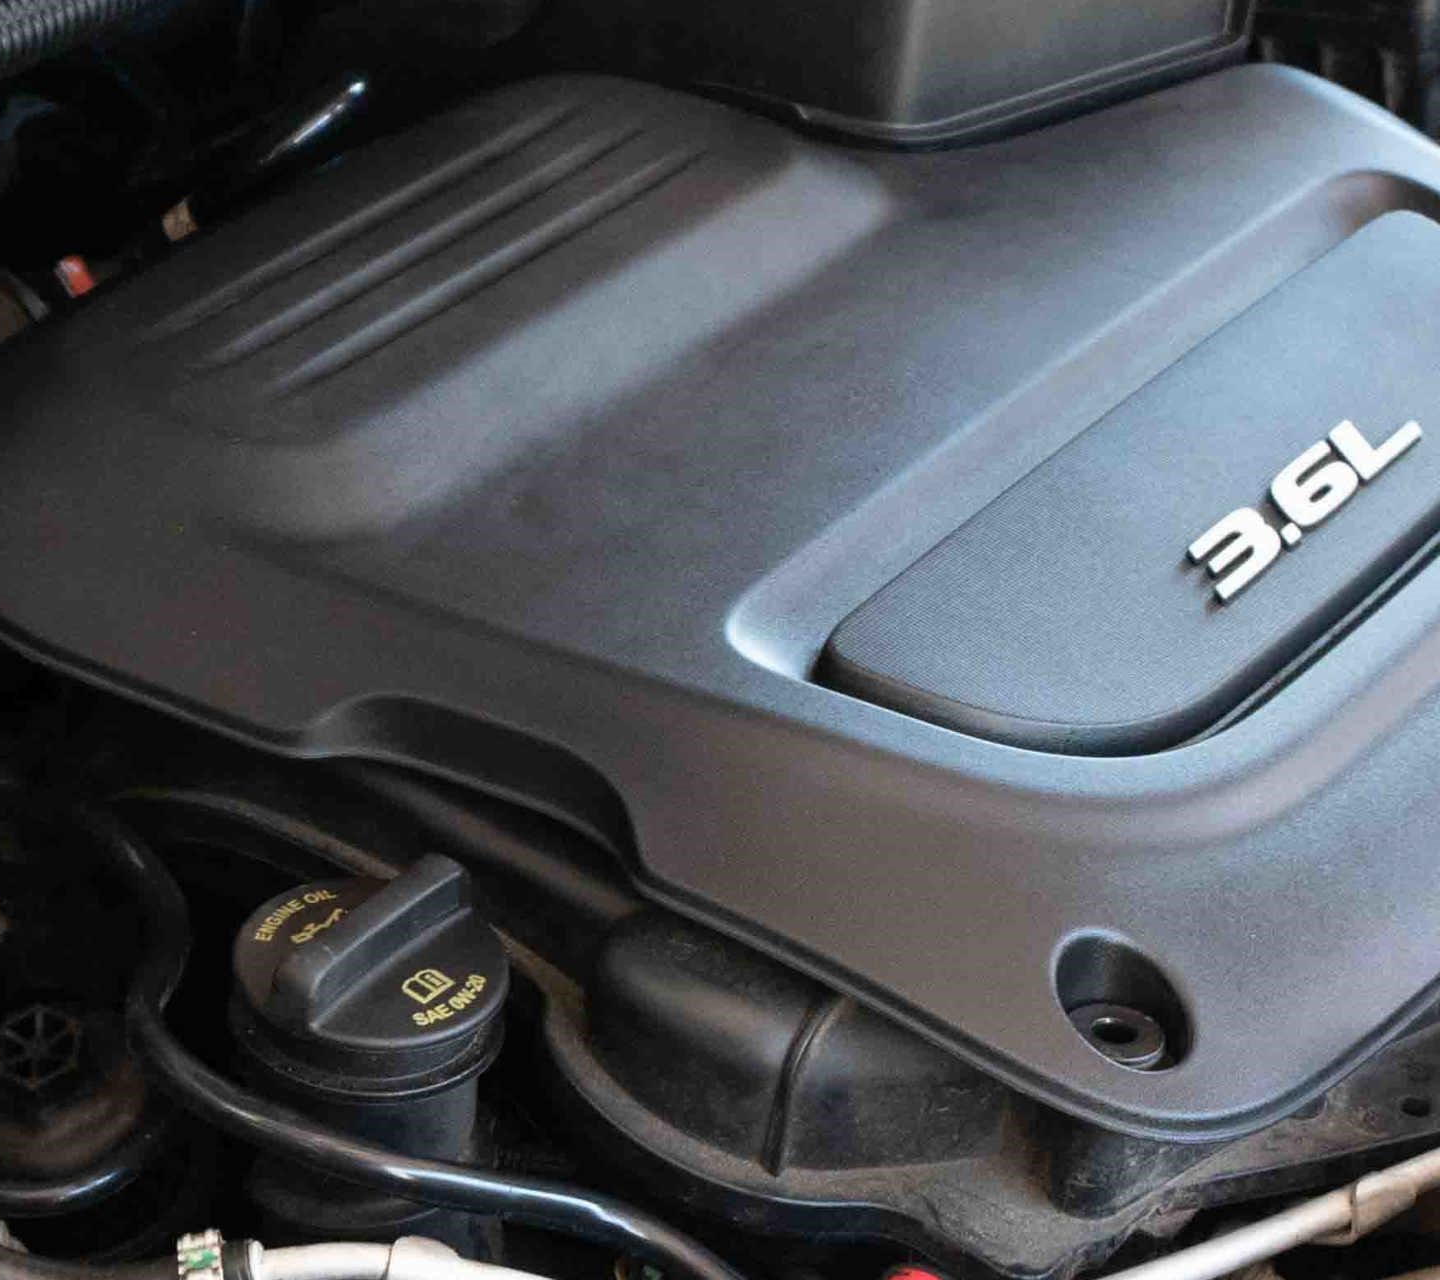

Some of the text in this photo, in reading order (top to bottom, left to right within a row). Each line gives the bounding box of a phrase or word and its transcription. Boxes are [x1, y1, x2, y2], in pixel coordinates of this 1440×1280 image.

[1187, 419, 1423, 600] 3.6L
[255, 887, 337, 943] ENGINE OIL
[412, 974, 487, 1027] SAE 0W-20
